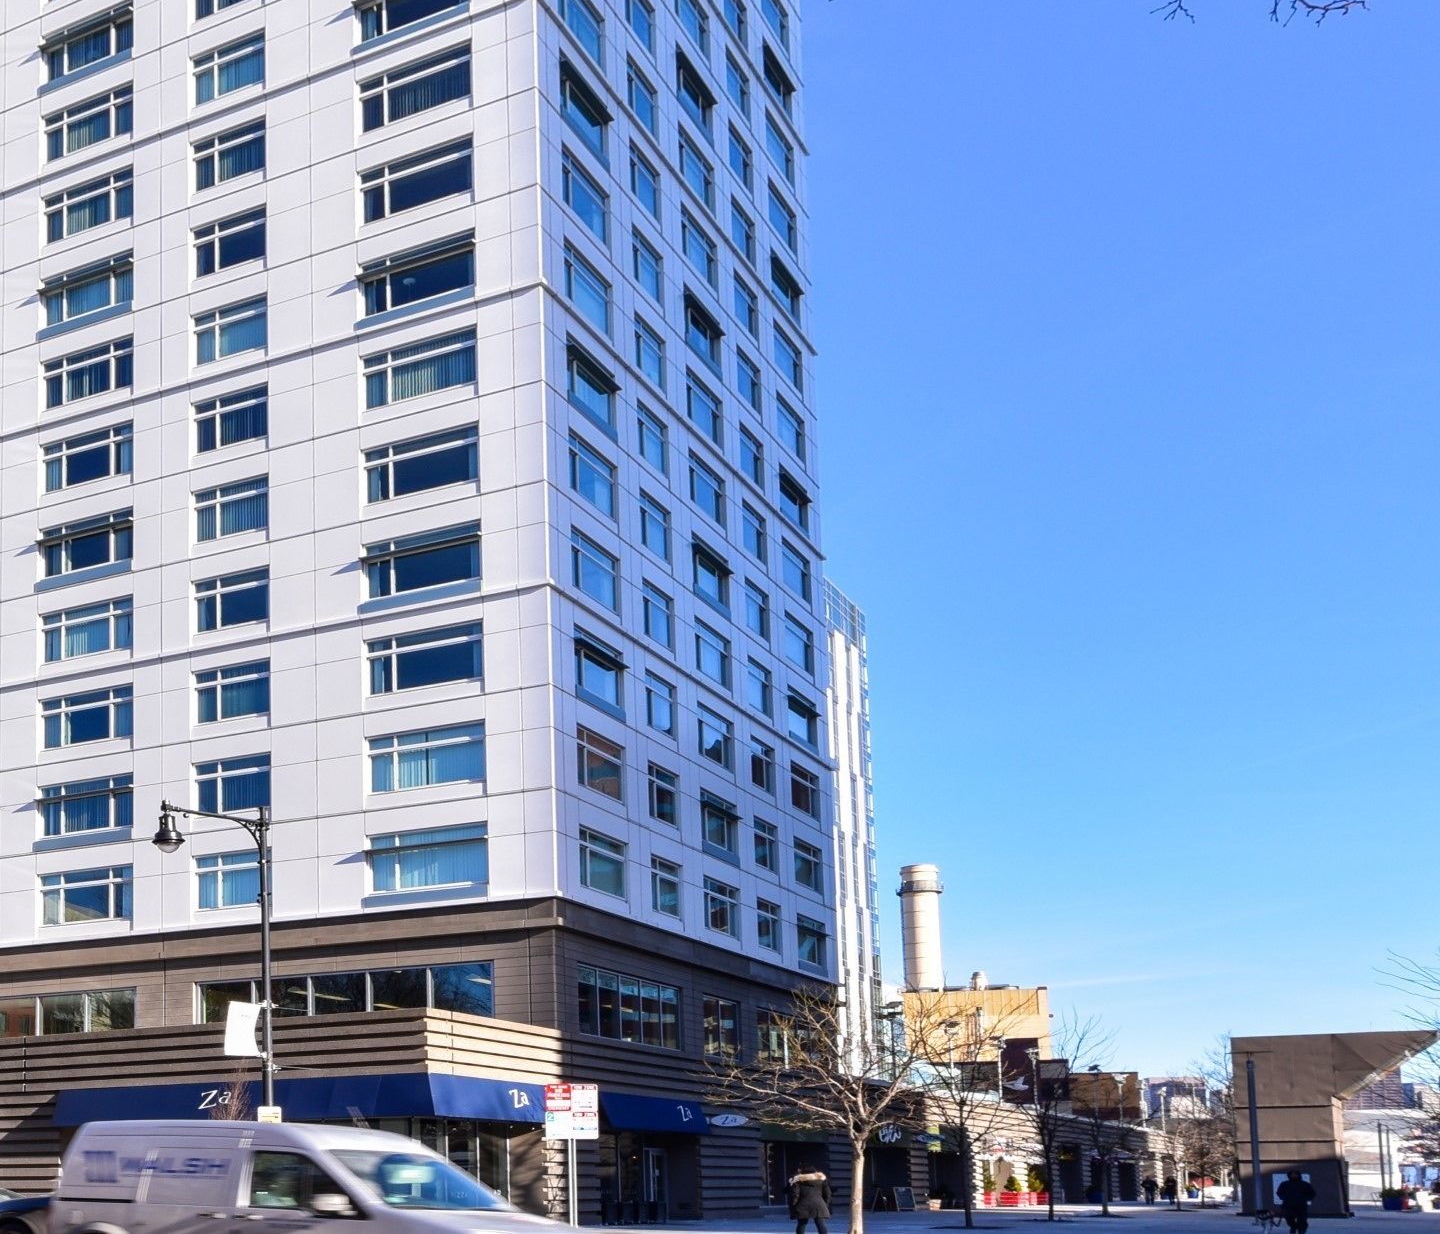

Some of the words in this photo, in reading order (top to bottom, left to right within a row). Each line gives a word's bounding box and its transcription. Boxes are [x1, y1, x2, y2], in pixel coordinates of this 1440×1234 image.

[198, 1089, 232, 1110] Za
[508, 1089, 530, 1108] Za
[677, 1105, 693, 1122] Za
[721, 1116, 737, 1125] Za
